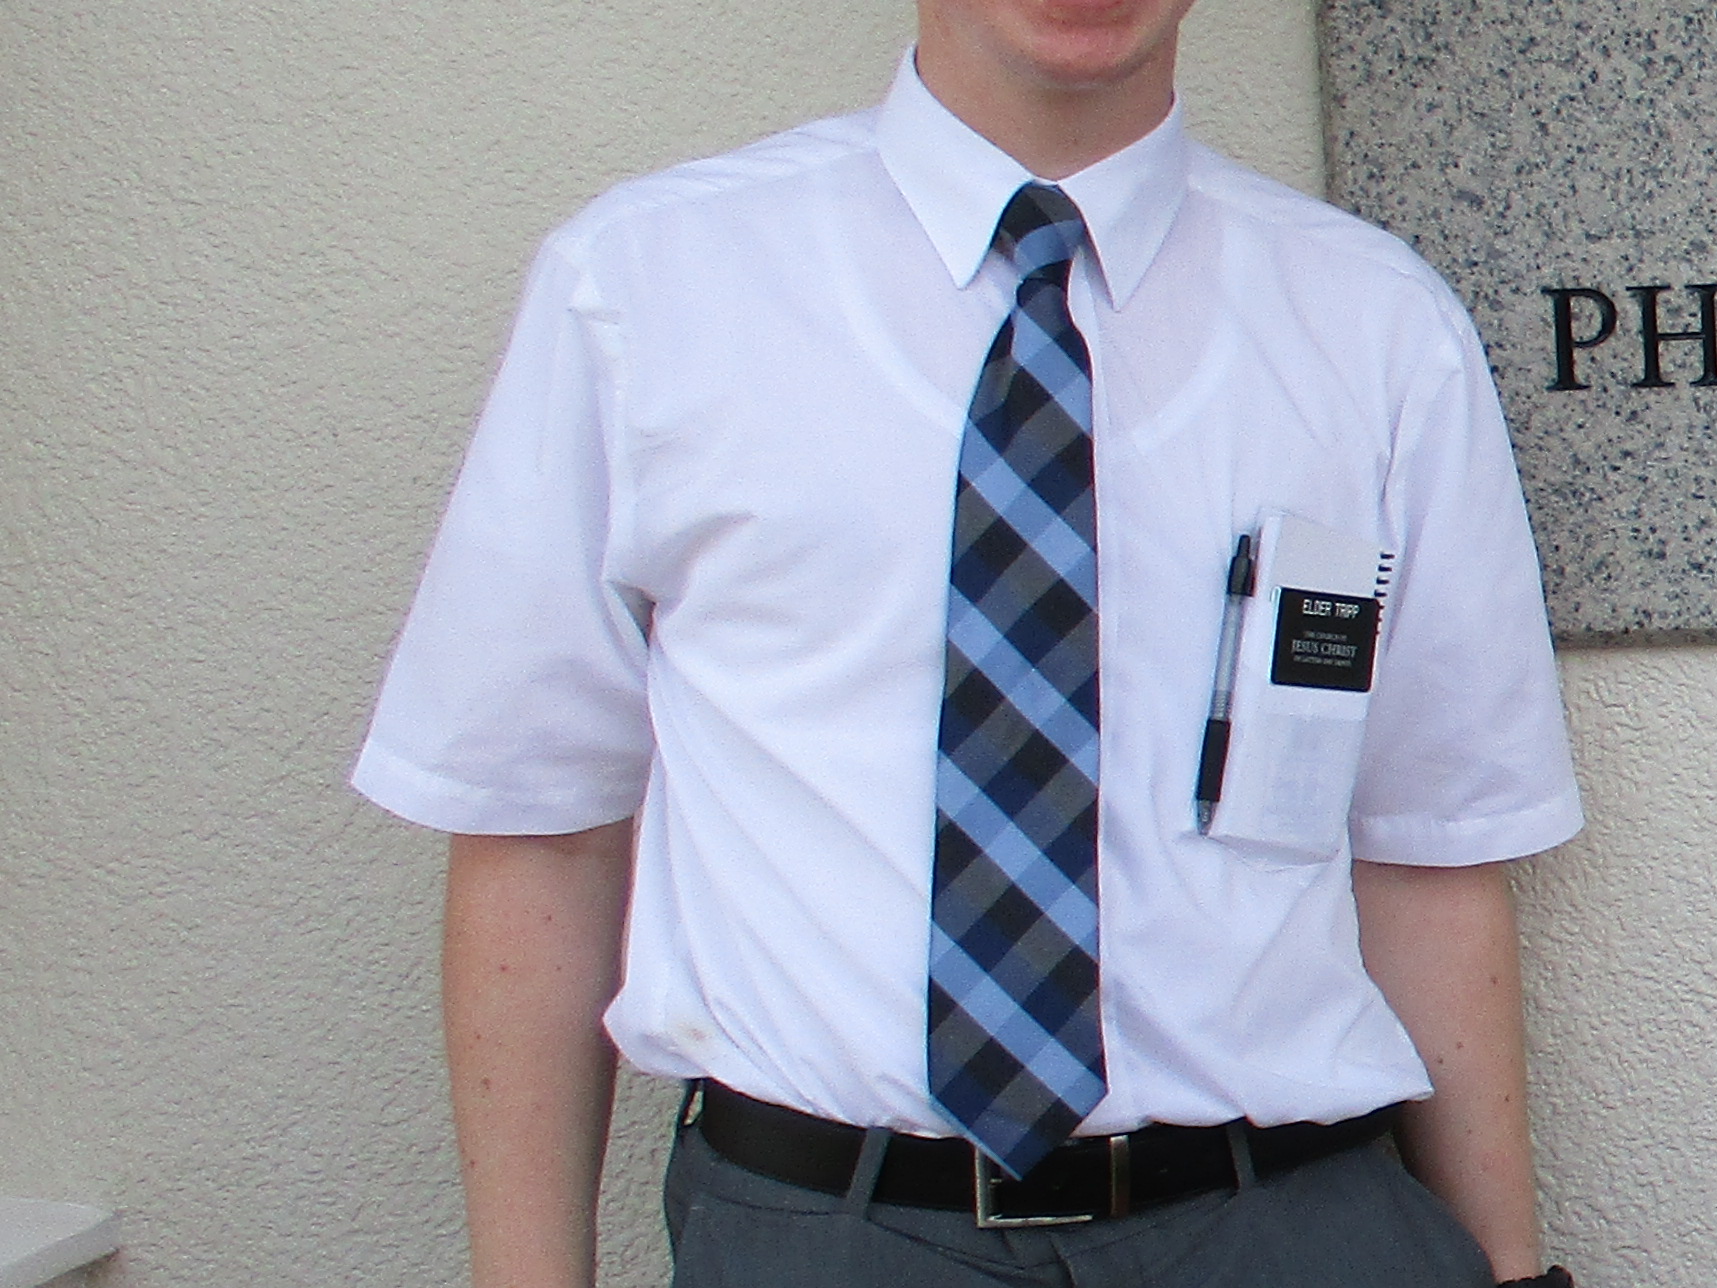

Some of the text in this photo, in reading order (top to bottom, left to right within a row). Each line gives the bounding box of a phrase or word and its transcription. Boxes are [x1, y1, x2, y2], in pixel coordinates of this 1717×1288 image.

[1303, 599, 1332, 616] ELDER
[1292, 639, 1357, 658] JESUS CHRIST
